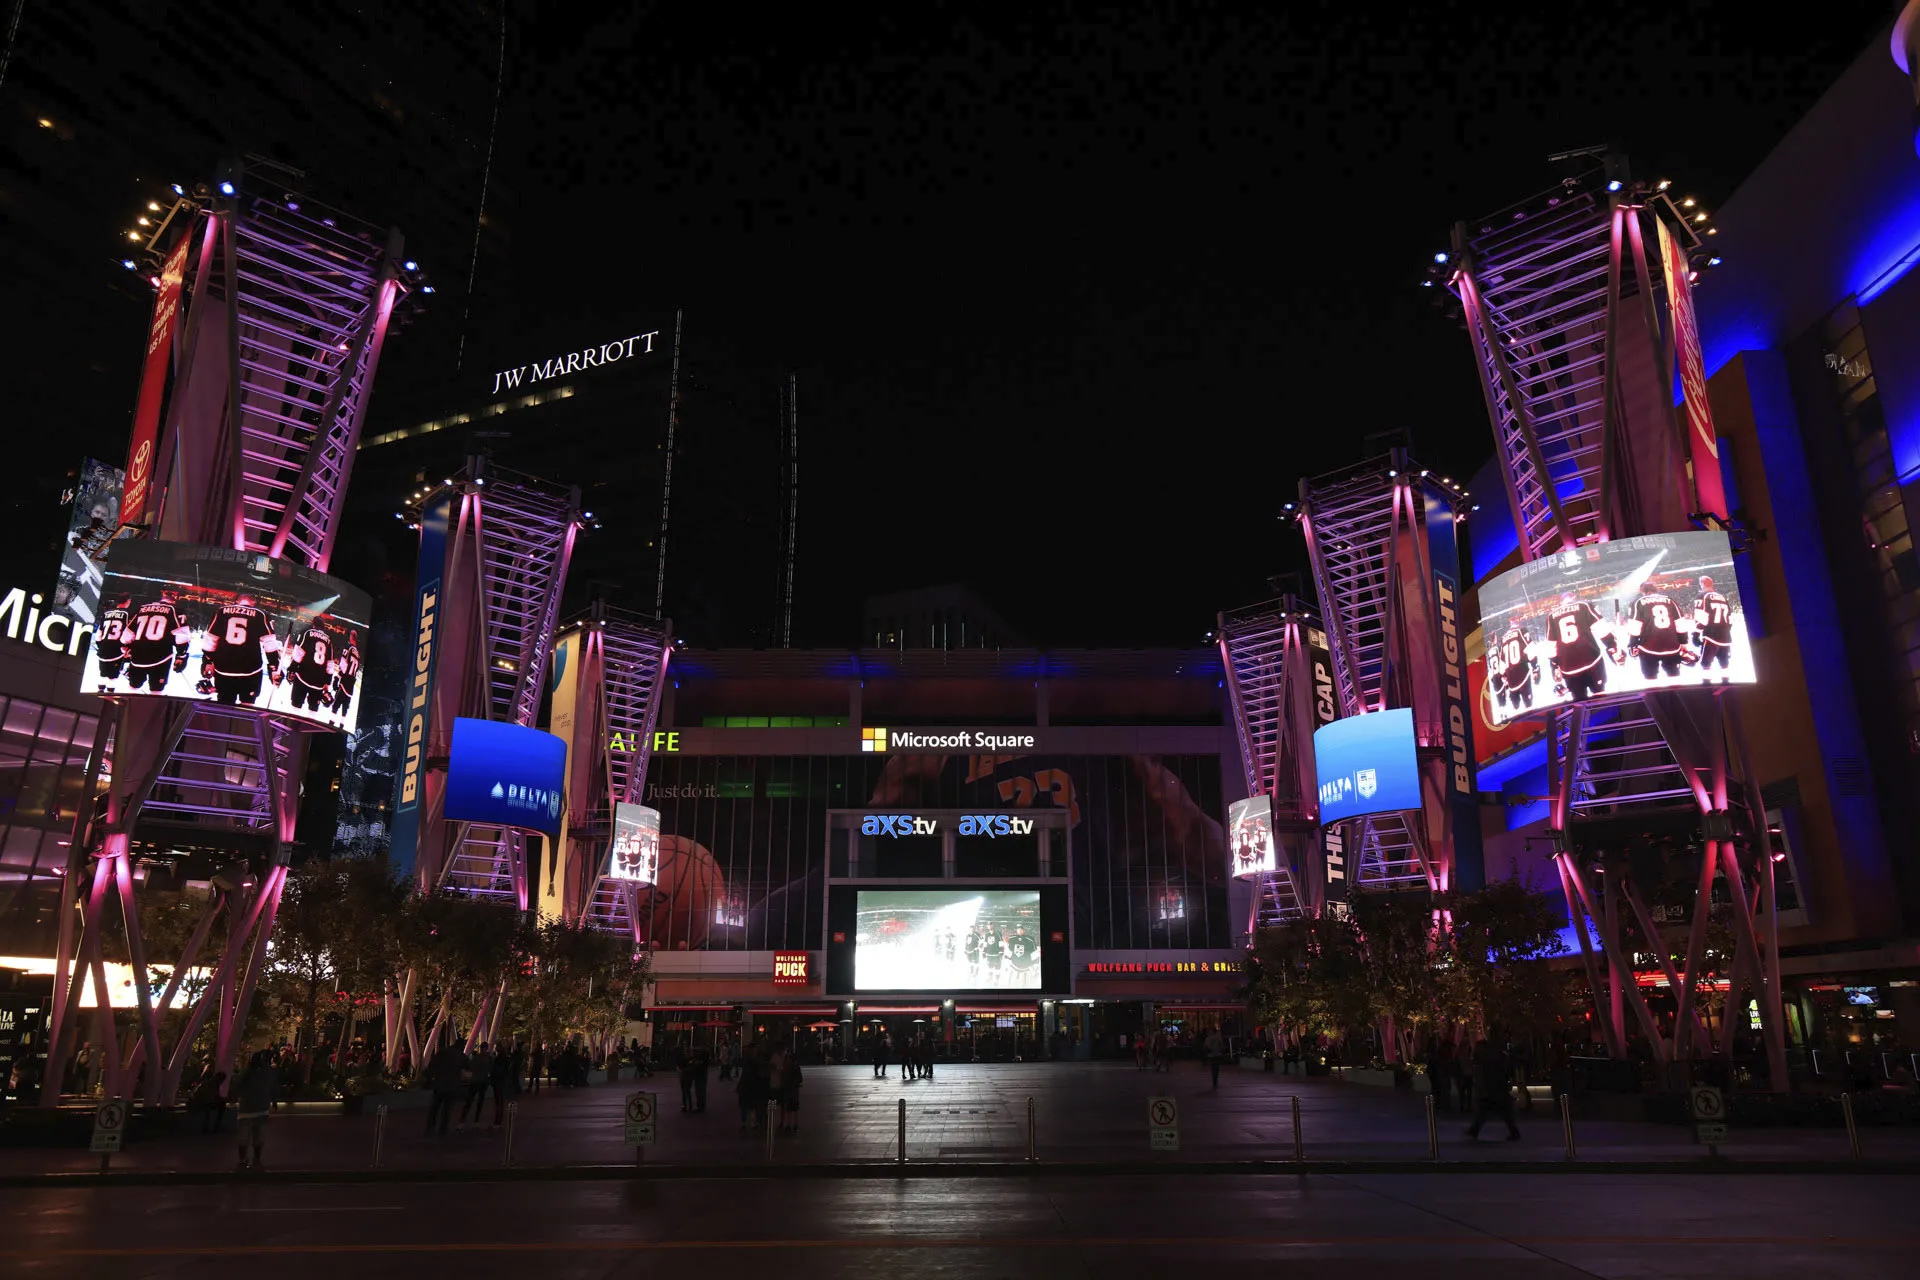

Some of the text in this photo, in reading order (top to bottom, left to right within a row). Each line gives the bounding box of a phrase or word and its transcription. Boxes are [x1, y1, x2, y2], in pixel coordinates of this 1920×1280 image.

[492, 330, 659, 394] JW MARRIOTT
[223, 607, 256, 617] MUZZIN
[1652, 605, 1671, 629] 8
[225, 617, 248, 645] 6
[1558, 615, 1579, 644] 6
[314, 641, 326, 666] 8
[1315, 663, 1335, 722] CAP
[892, 732, 1034, 750] Microsoft Square
[1450, 704, 1470, 793] BUD
[402, 713, 423, 804] BUD
[508, 783, 547, 805] DELTA
[647, 783, 720, 800] Just do it.
[775, 962, 806, 977] PUCK
[1088, 962, 1143, 973] WOLFGANG
[1147, 962, 1173, 973] PUCK
[1177, 962, 1197, 972] BAR
[1201, 962, 1209, 972] &
